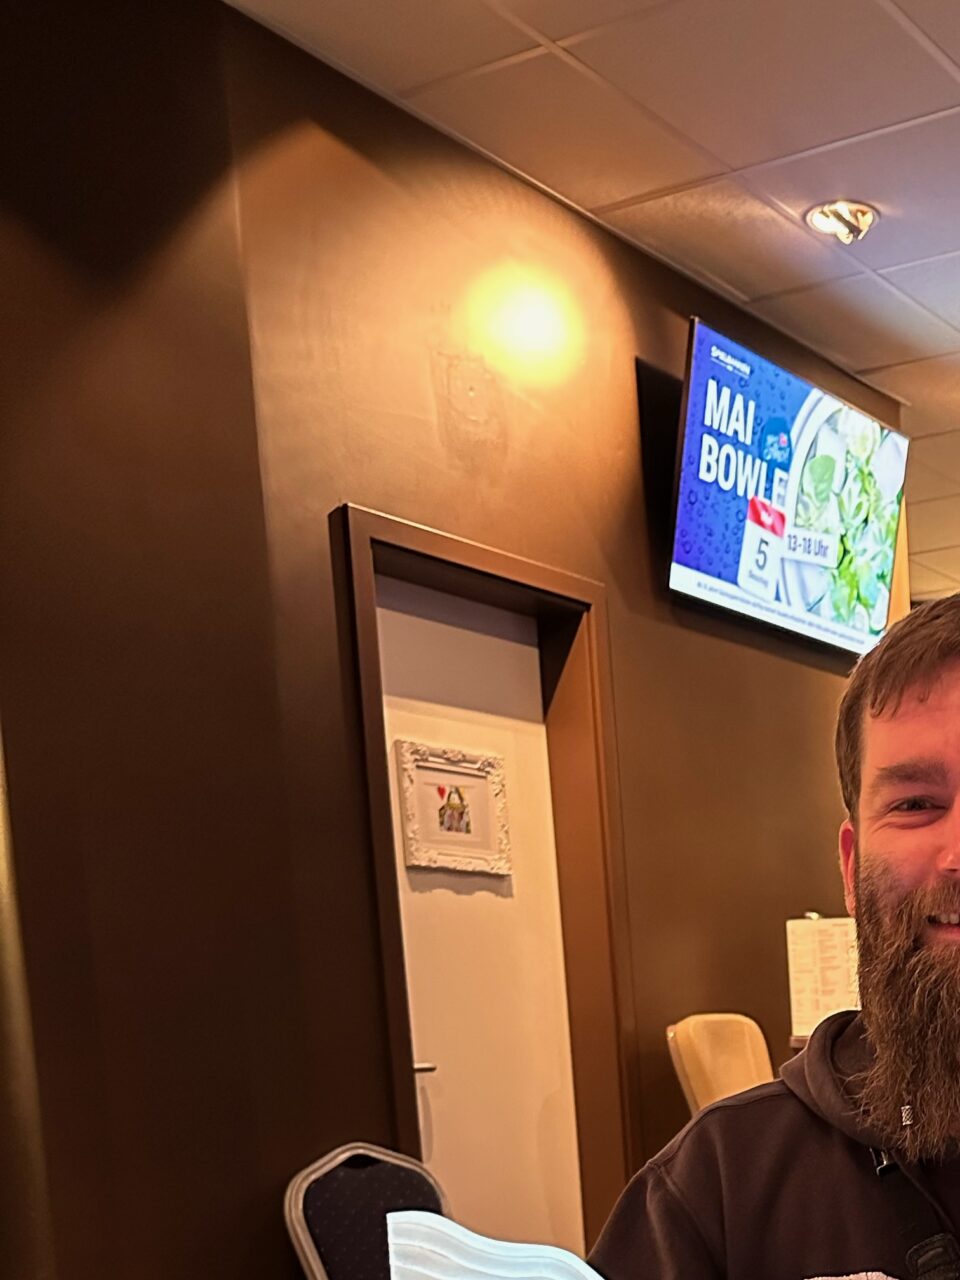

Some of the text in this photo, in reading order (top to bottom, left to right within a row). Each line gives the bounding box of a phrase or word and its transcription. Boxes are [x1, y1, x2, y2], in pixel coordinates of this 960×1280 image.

[703, 379, 756, 446] MAI
[698, 433, 788, 511] BOWLE
[755, 538, 769, 571] 5
